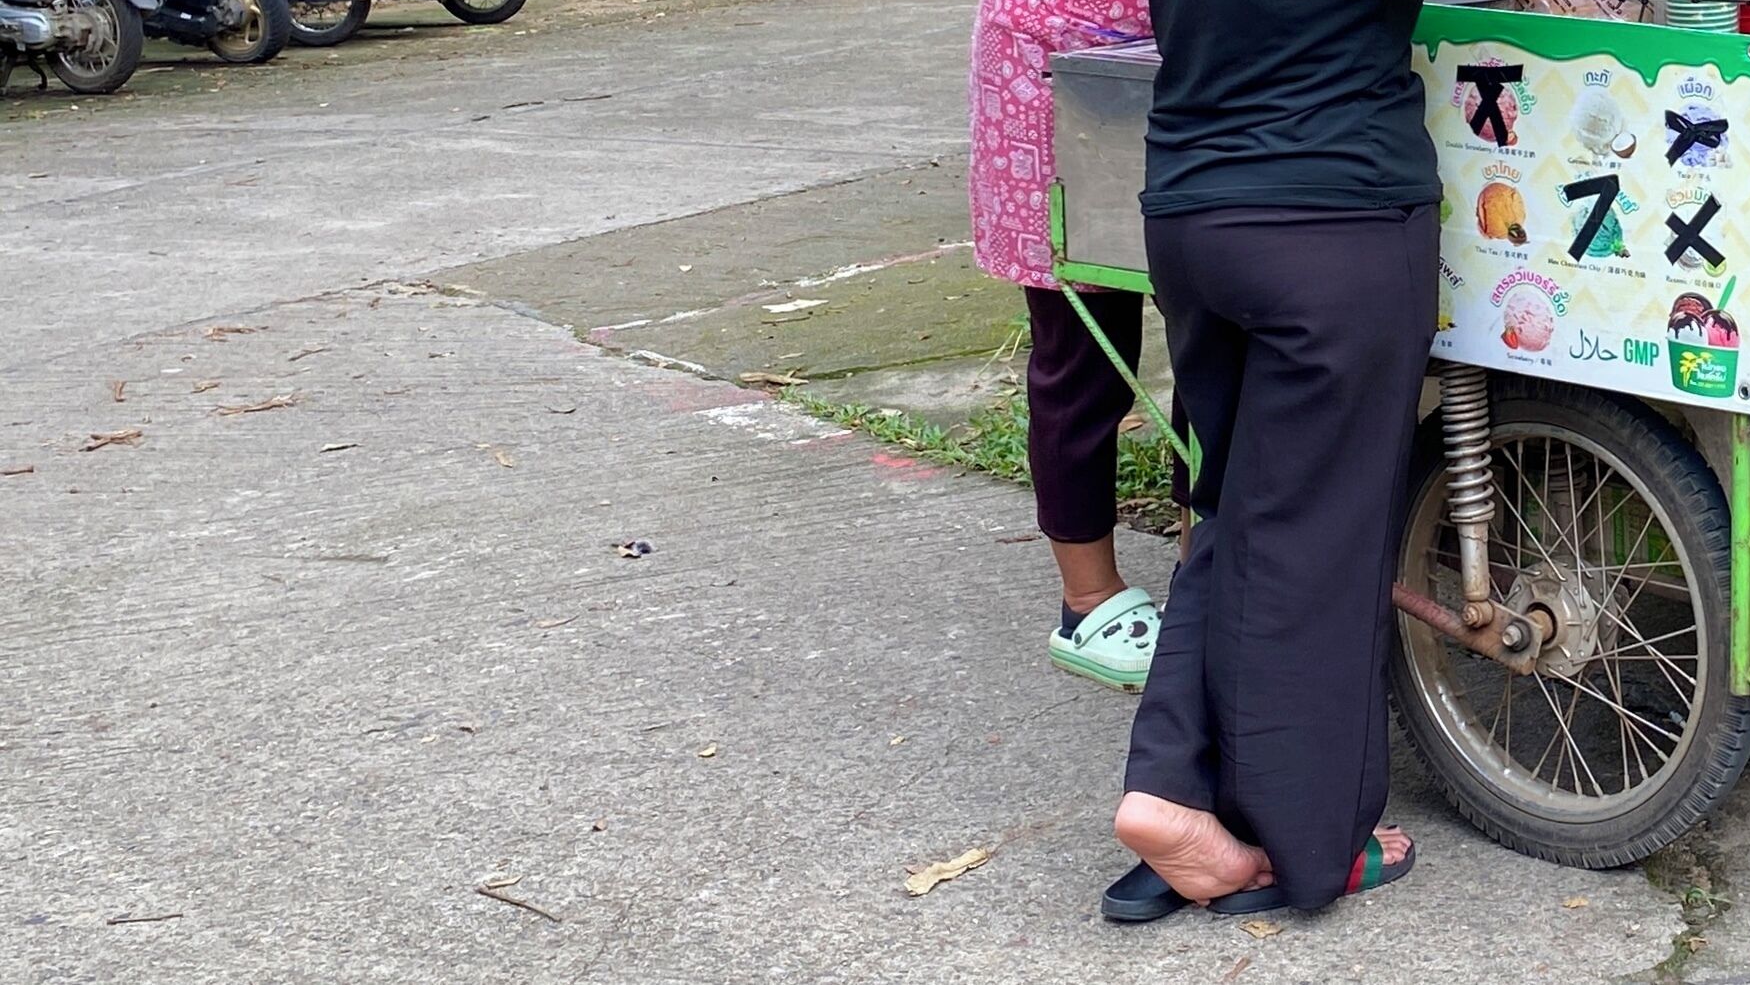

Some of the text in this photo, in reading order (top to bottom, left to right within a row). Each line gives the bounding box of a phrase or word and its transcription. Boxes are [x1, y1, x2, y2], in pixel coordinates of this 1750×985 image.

[1585, 69, 1611, 85] กะทิ
[1483, 160, 1520, 179] ชาไทย
[1569, 328, 1618, 361] حلال
[1623, 338, 1659, 366] GMP
